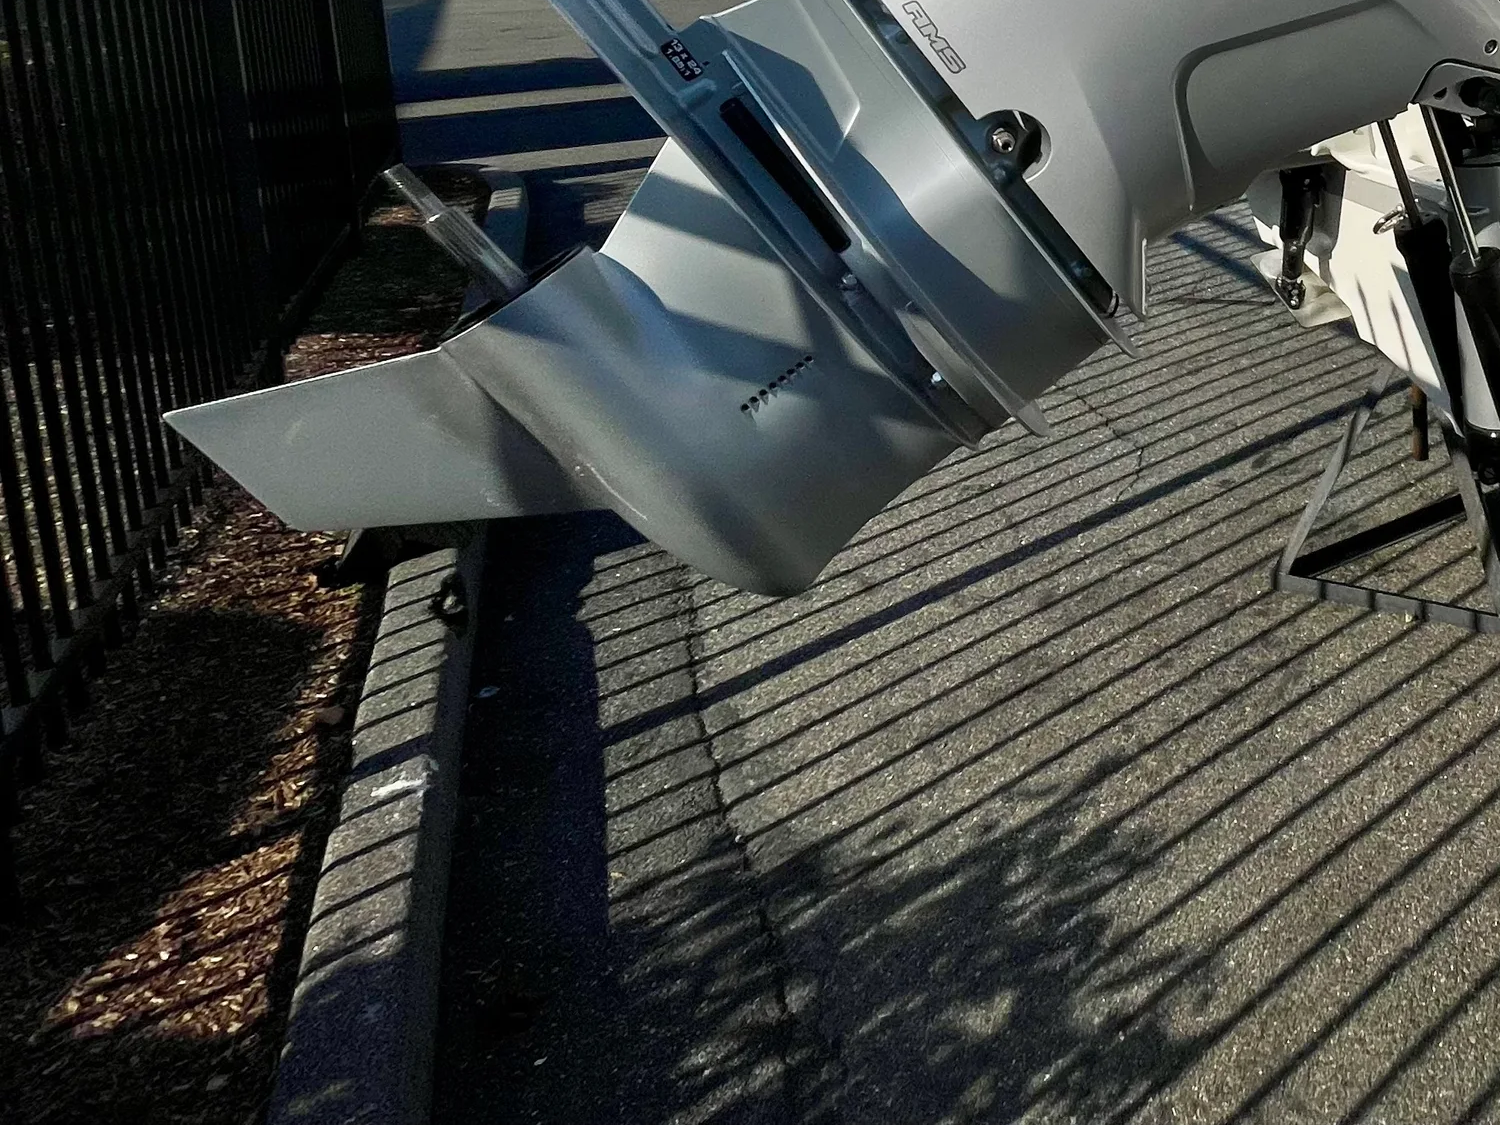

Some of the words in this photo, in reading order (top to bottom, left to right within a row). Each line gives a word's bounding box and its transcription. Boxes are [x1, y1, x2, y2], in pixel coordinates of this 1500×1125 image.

[671, 39, 683, 52] 13
[687, 60, 701, 75] 24
[902, 0, 967, 74] AMS
